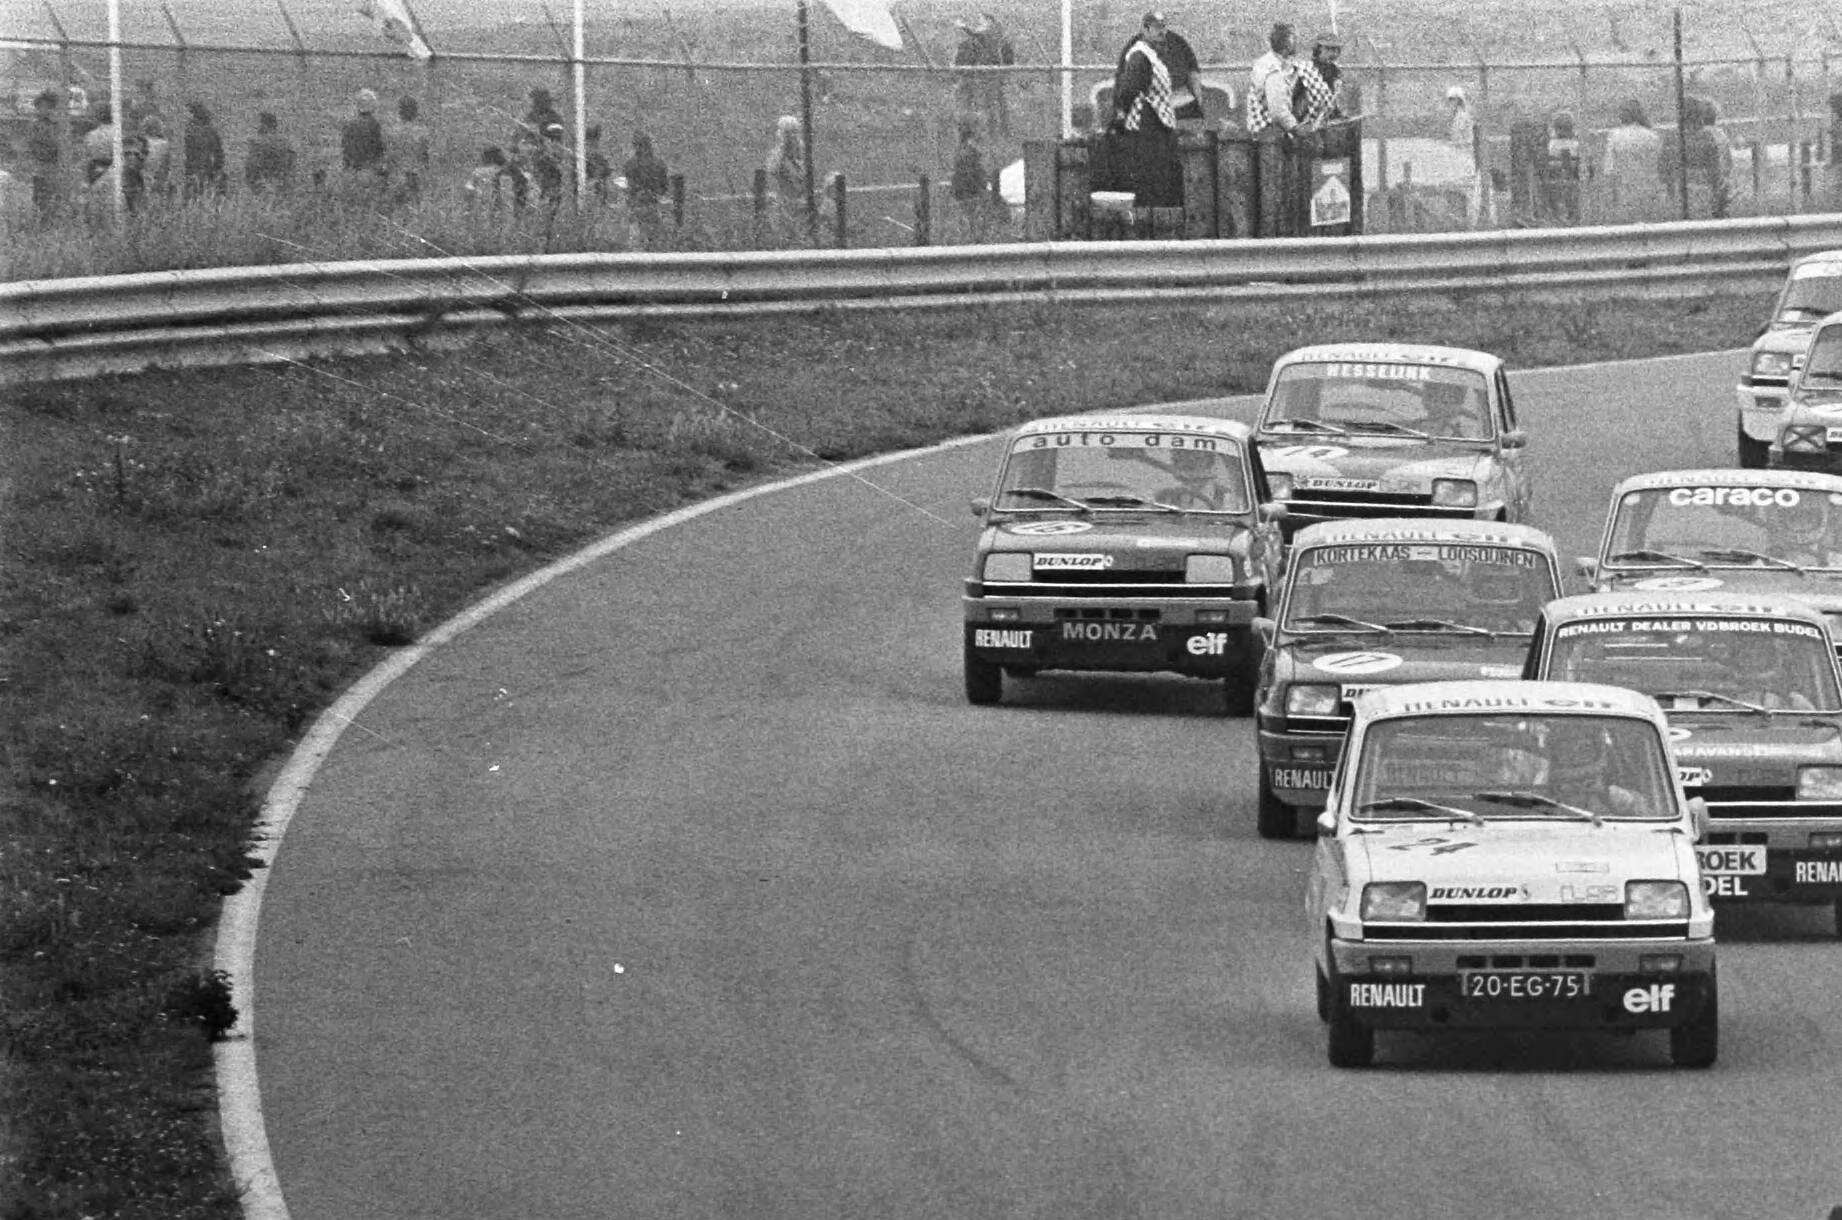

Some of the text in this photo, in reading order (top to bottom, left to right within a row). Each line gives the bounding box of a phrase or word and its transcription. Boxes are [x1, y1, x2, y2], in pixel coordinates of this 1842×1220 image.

[1032, 431, 1217, 450] auto dam
[1669, 487, 1800, 507] caraco
[1036, 557, 1102, 566] DUNLOP
[1316, 546, 1411, 565] KORTEKAAS
[975, 629, 1033, 649] RENAULT
[1062, 622, 1157, 640] MONZA
[1559, 620, 1626, 638] RENAULT
[1632, 621, 1691, 633] DEALER
[1774, 622, 1822, 640] BUDEL
[1186, 632, 1228, 655] elf
[1329, 653, 1390, 668] 17
[1429, 886, 1518, 900] DUNLOP
[1350, 984, 1426, 1007] RENAULT
[1471, 976, 1580, 998] 20-EG-75
[1622, 983, 1676, 1013] elf
